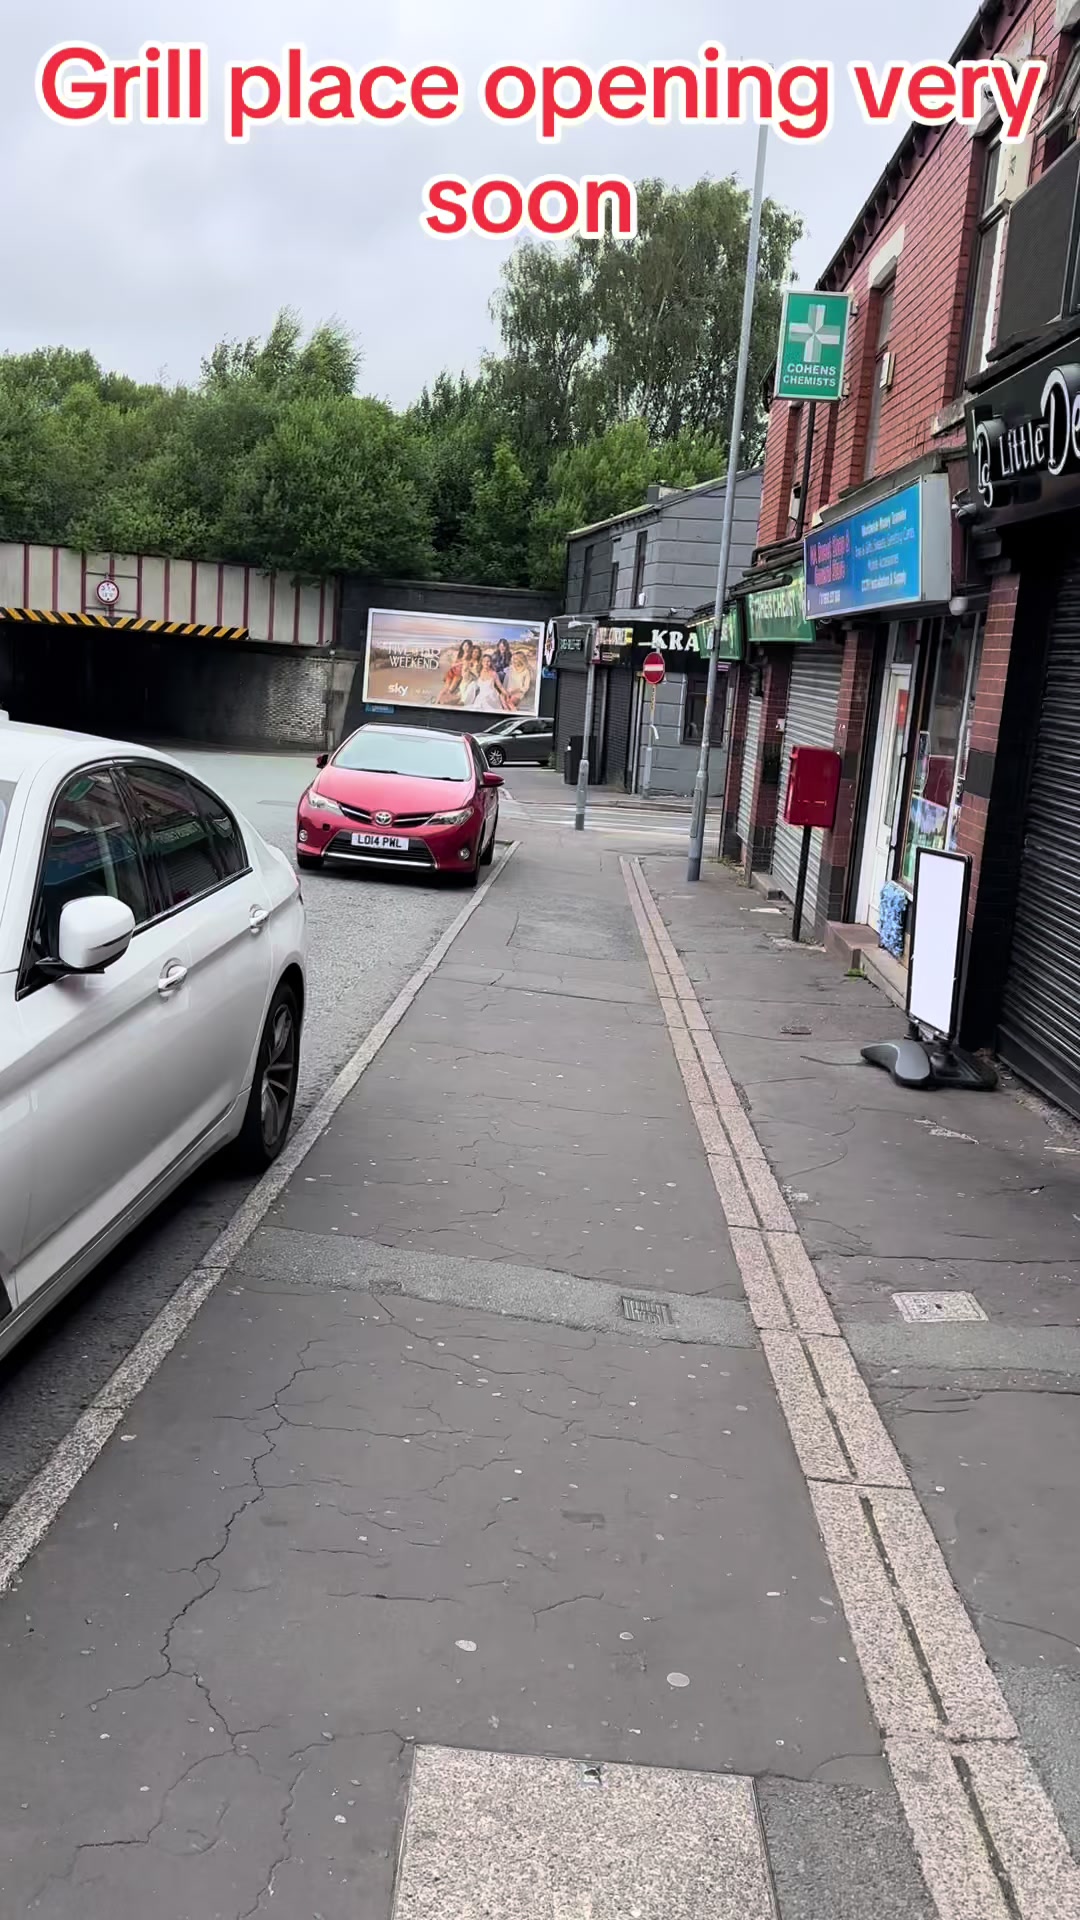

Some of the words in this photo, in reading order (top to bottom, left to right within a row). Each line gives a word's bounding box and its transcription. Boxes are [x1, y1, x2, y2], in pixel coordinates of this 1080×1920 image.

[787, 362, 837, 376] COHENS
[783, 374, 837, 387] CHEMISTS
[999, 421, 1045, 477] Little
[389, 655, 440, 670] WEEKEND
[388, 682, 409, 697] sky
[357, 834, 380, 846] LO14
[382, 836, 402, 848] PWL
